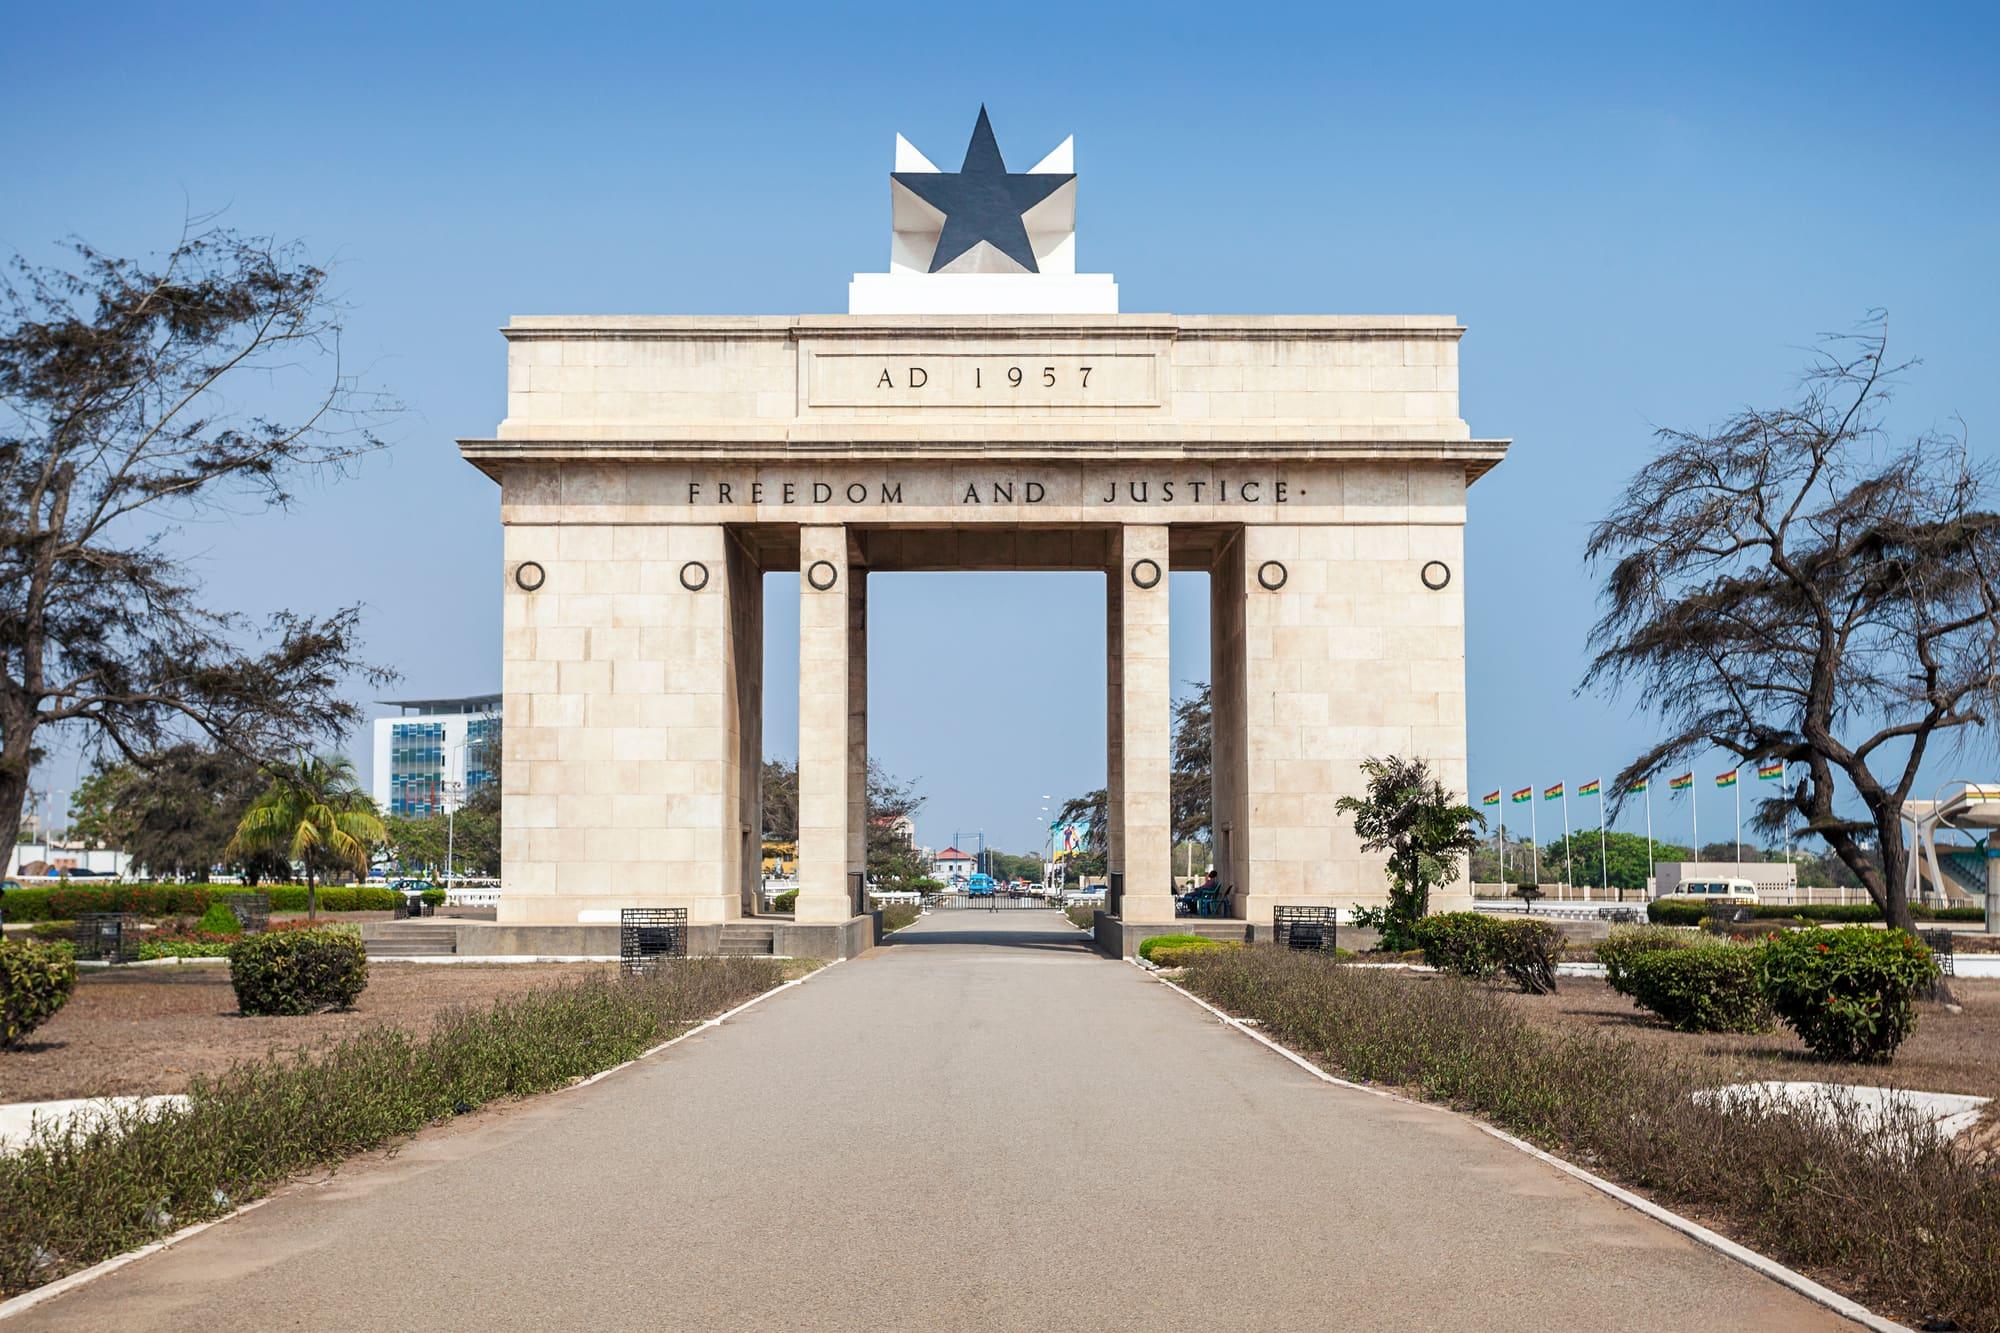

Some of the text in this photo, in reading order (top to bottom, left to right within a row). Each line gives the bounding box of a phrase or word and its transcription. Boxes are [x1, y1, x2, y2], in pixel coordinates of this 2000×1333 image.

[877, 366, 1093, 388] AD 1957
[688, 482, 903, 504] FREEDOM
[962, 482, 1045, 504] AND
